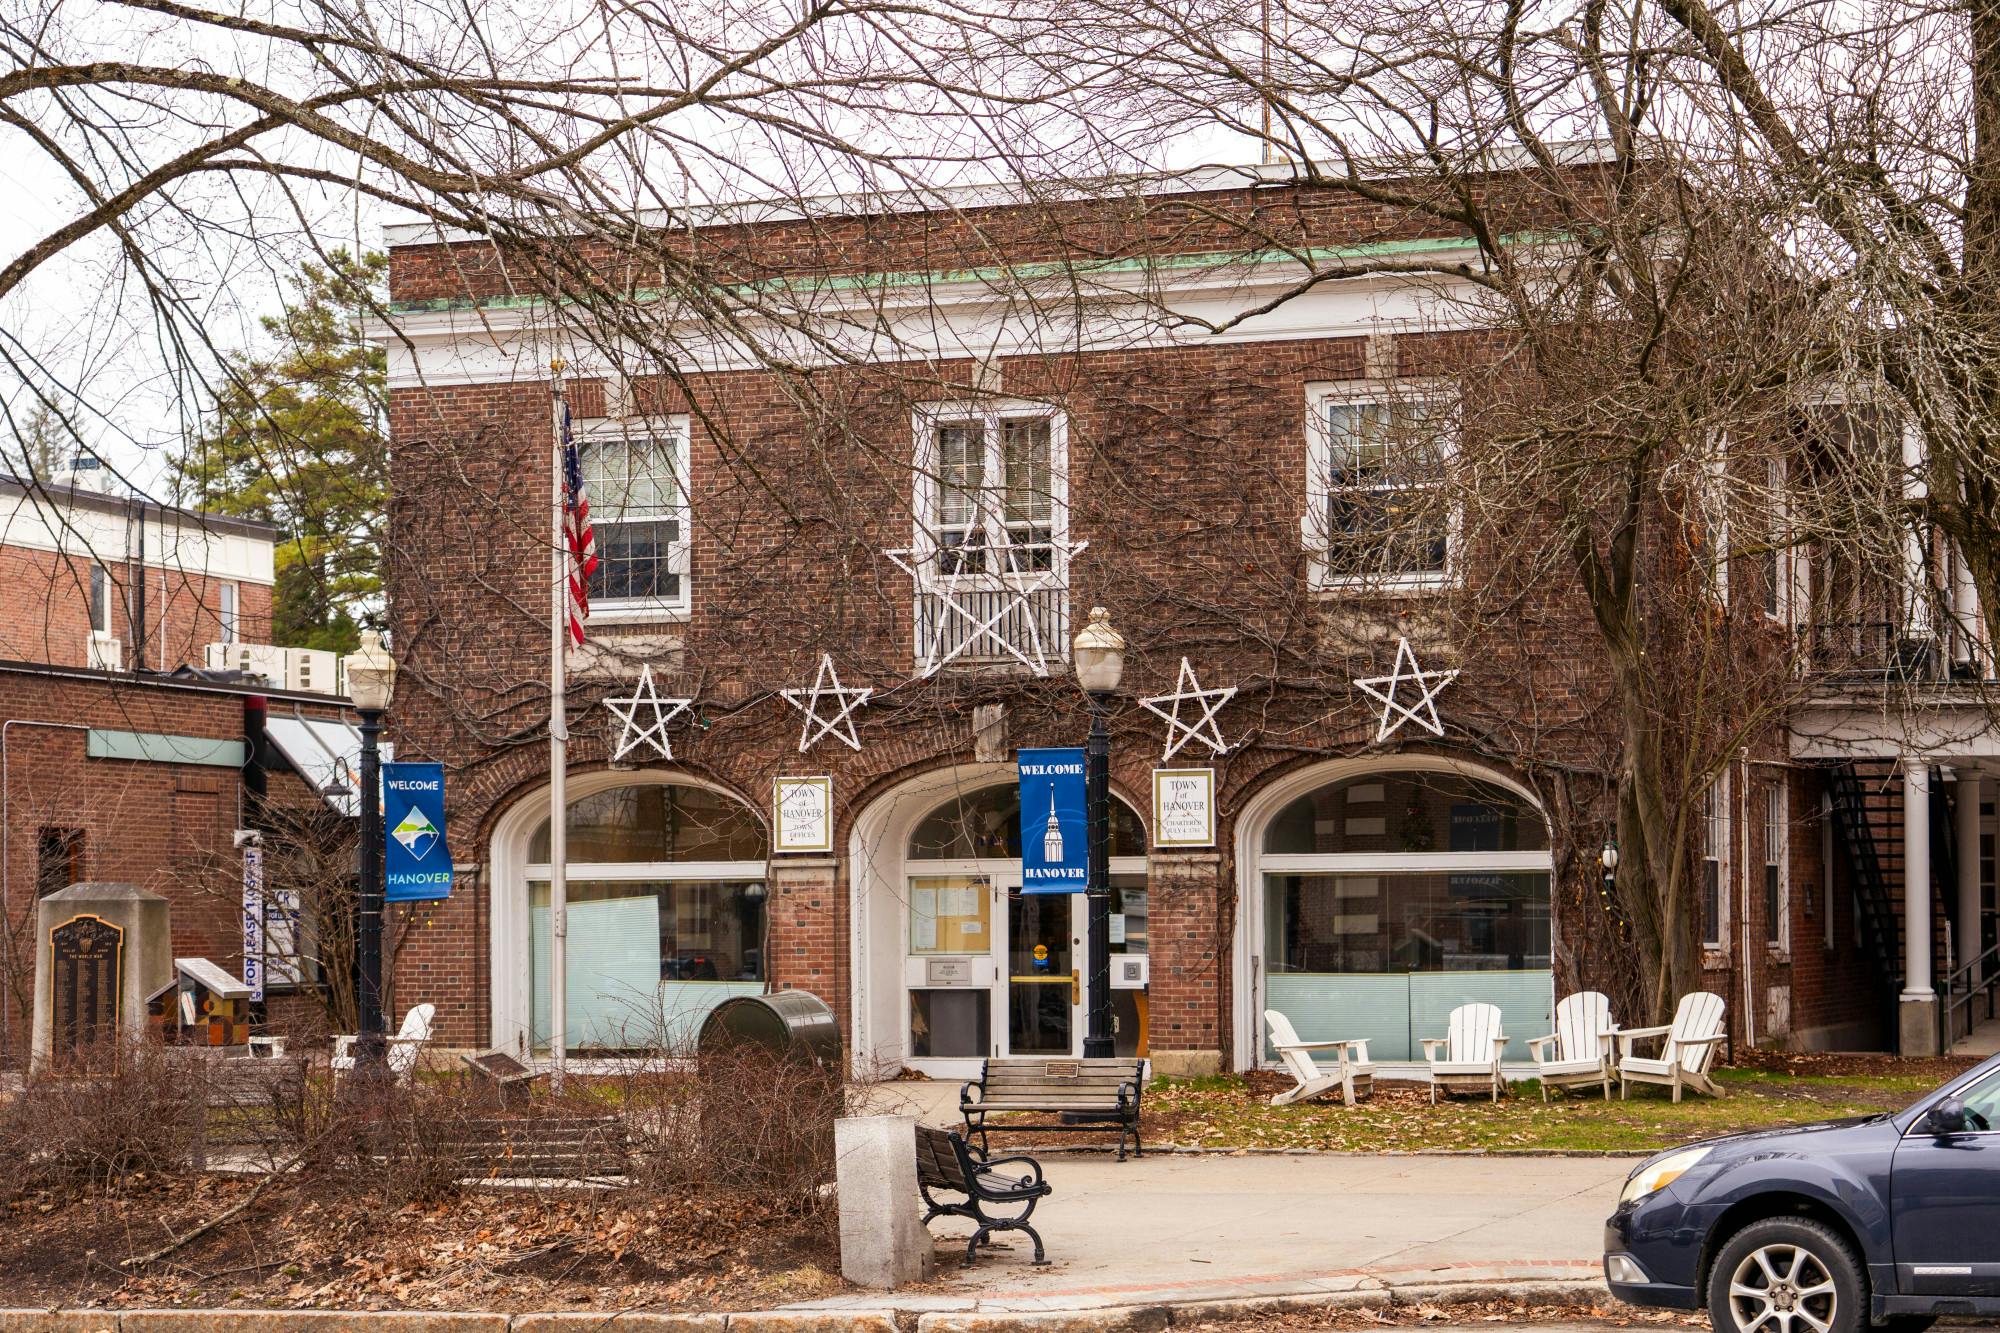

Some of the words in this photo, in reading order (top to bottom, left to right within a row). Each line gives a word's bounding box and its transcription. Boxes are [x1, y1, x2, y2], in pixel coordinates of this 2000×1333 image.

[1020, 764, 1083, 775] WELCOME
[388, 781, 439, 790] WELCOME
[1170, 781, 1197, 790] TOWN
[791, 789, 815, 798] TOWN
[1163, 802, 1205, 811] HANOVER
[783, 809, 823, 818] HANOVER
[1025, 868, 1085, 878] HANOVER
[388, 873, 450, 885] HANOVER
[246, 914, 256, 954] LEASE
[246, 958, 256, 986] FOR
